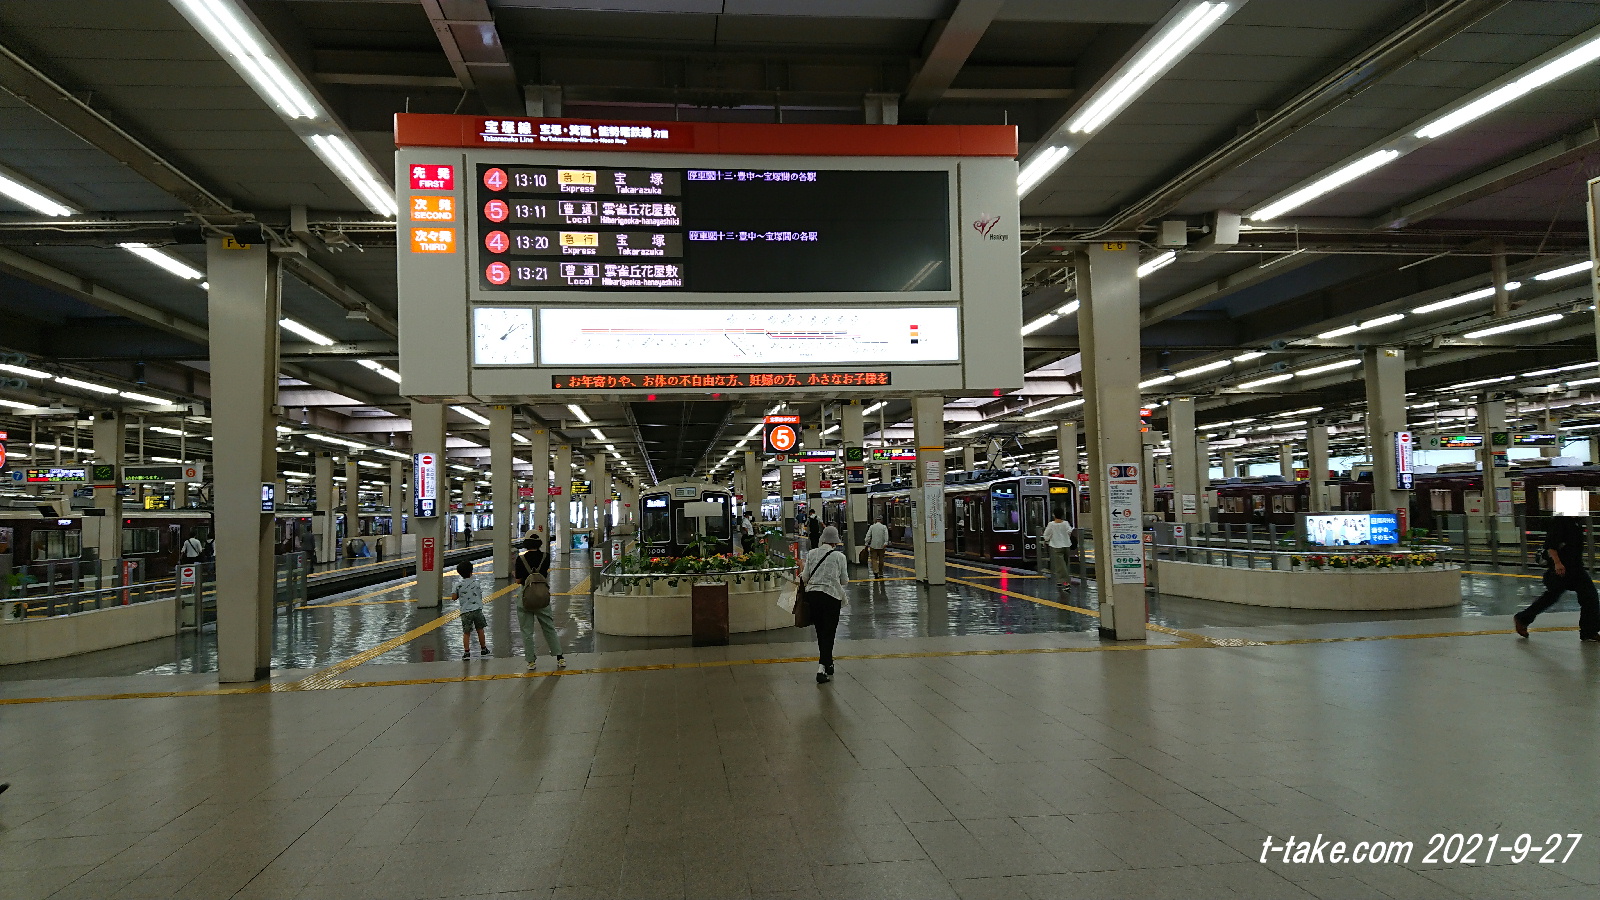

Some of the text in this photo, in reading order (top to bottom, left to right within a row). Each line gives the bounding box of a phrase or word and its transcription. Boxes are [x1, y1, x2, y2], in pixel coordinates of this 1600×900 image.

[413, 167, 450, 179] 先発
[419, 180, 445, 188] FIRST
[487, 171, 664, 188] 4 13:10 急行 宝塚
[560, 185, 662, 195] Express Takarazuka
[414, 199, 451, 211] 次発
[414, 211, 452, 220] SECOND
[490, 203, 677, 219] 5 13:11 普通 雲雀丘花屋敷
[566, 216, 591, 224] Local
[415, 230, 452, 242] 次々発
[489, 233, 666, 250] 4 13:20 急行 宝塚
[989, 234, 1009, 242] Hankyu
[419, 243, 447, 251] THIRD
[562, 246, 664, 256] Express Takarazuka
[492, 264, 679, 281] 5 13:21 普通 雲雀丘花屋敷
[567, 277, 593, 286] Local
[776, 429, 790, 448] 5
